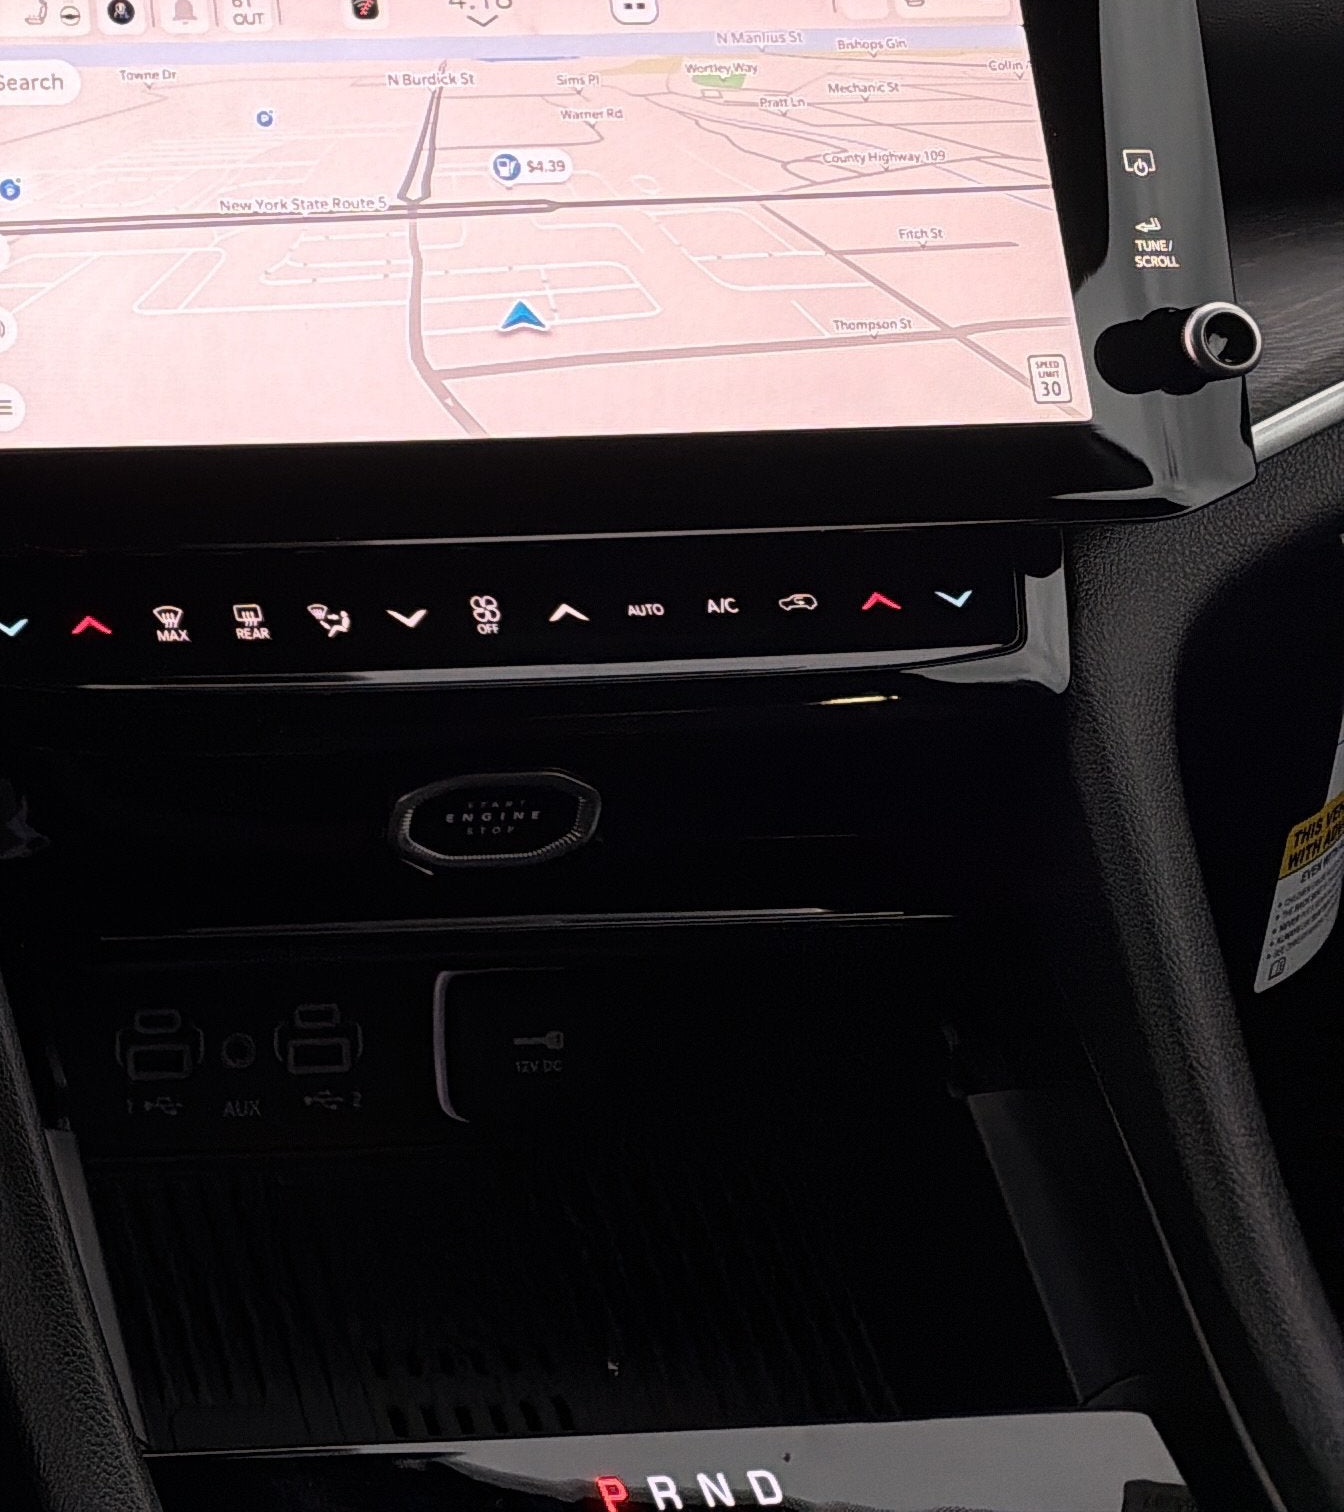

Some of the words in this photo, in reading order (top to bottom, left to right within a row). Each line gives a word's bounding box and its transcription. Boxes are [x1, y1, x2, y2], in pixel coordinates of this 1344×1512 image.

[232, 11, 264, 26] OUT
[717, 32, 728, 44] N
[731, 31, 786, 44] Manlius
[789, 31, 803, 43] St
[120, 70, 159, 81] Towne
[162, 69, 177, 80] Dr
[733, 63, 758, 75] Way
[388, 74, 399, 86] N
[403, 72, 456, 86] Burdick
[460, 72, 475, 85] St
[556, 74, 585, 86] Sims
[828, 82, 885, 94] Mechanic
[887, 82, 900, 93] St
[791, 98, 806, 109] Ln
[606, 108, 624, 119] Rd
[823, 151, 866, 164] County
[869, 150, 920, 164] Highway
[923, 150, 945, 161] 109
[526, 159, 566, 173] $4.39
[220, 199, 252, 211] New
[255, 198, 292, 211] York
[294, 198, 330, 210] State
[332, 197, 376, 210] Route
[378, 197, 388, 209] 5
[930, 228, 944, 239] St
[1134, 239, 1173, 253] TUNE/
[1134, 255, 1180, 269] SCROLL
[832, 319, 897, 332] Thompson
[900, 319, 913, 330] St
[1041, 381, 1062, 397] 30
[628, 603, 665, 617] AUTO
[707, 597, 739, 614] A/C
[156, 629, 192, 642] MAX
[236, 626, 271, 640] REAR
[477, 623, 500, 635] OFF
[445, 811, 542, 824] ENGINE
[466, 824, 516, 836] STOP
[1295, 821, 1322, 848] THIS
[1289, 840, 1321, 870] WITH
[543, 1059, 564, 1073] DC
[222, 1100, 262, 1118] AUX
[596, 1476, 628, 1512] P
[647, 1476, 683, 1510] R
[697, 1473, 736, 1507] N
[747, 1469, 783, 1505] D
